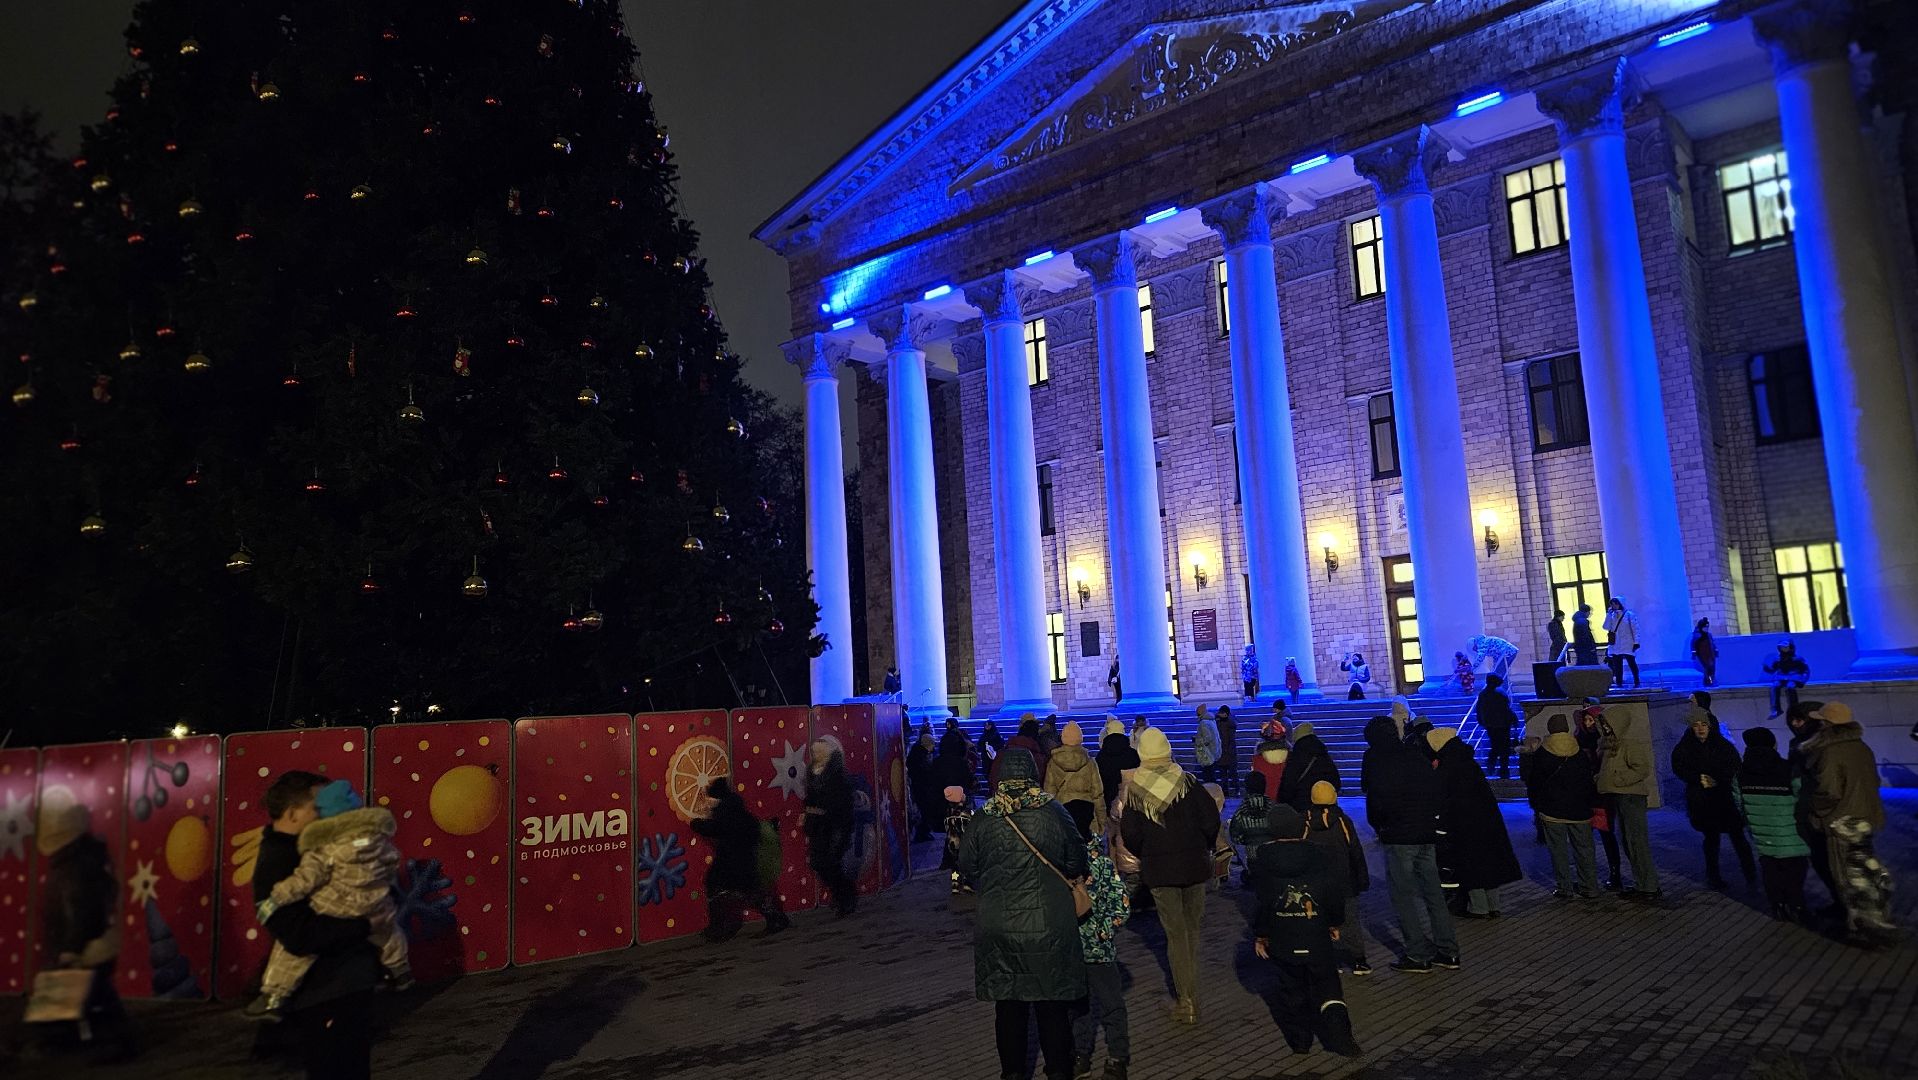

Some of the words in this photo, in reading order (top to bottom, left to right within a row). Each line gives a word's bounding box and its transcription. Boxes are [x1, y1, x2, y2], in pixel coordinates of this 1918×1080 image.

[520, 808, 628, 846] зима
[521, 851, 528, 861] в
[533, 840, 627, 859] подмосковье
